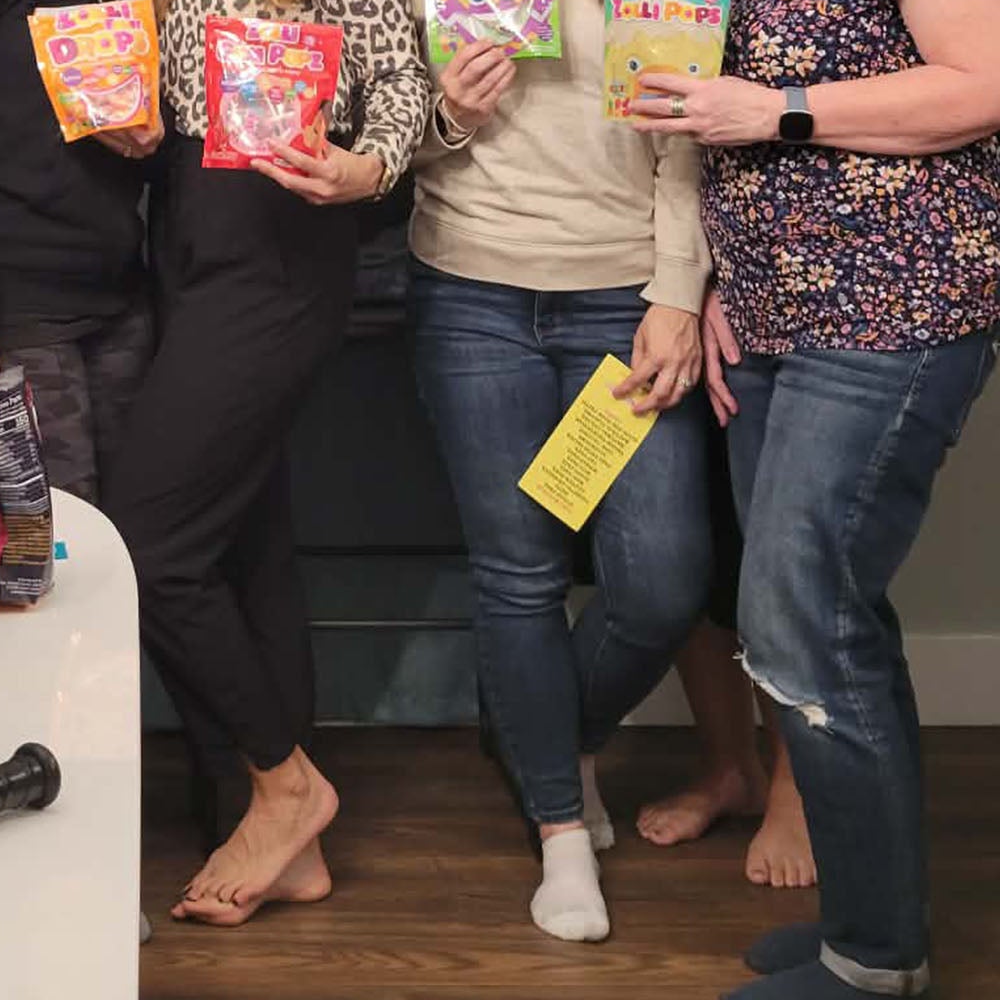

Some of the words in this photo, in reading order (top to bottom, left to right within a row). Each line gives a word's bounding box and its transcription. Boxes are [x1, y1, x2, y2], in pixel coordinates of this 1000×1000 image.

[55, 2, 131, 31] ZOLLI
[663, 0, 722, 26] POPS
[245, 22, 301, 44] ZOLLI
